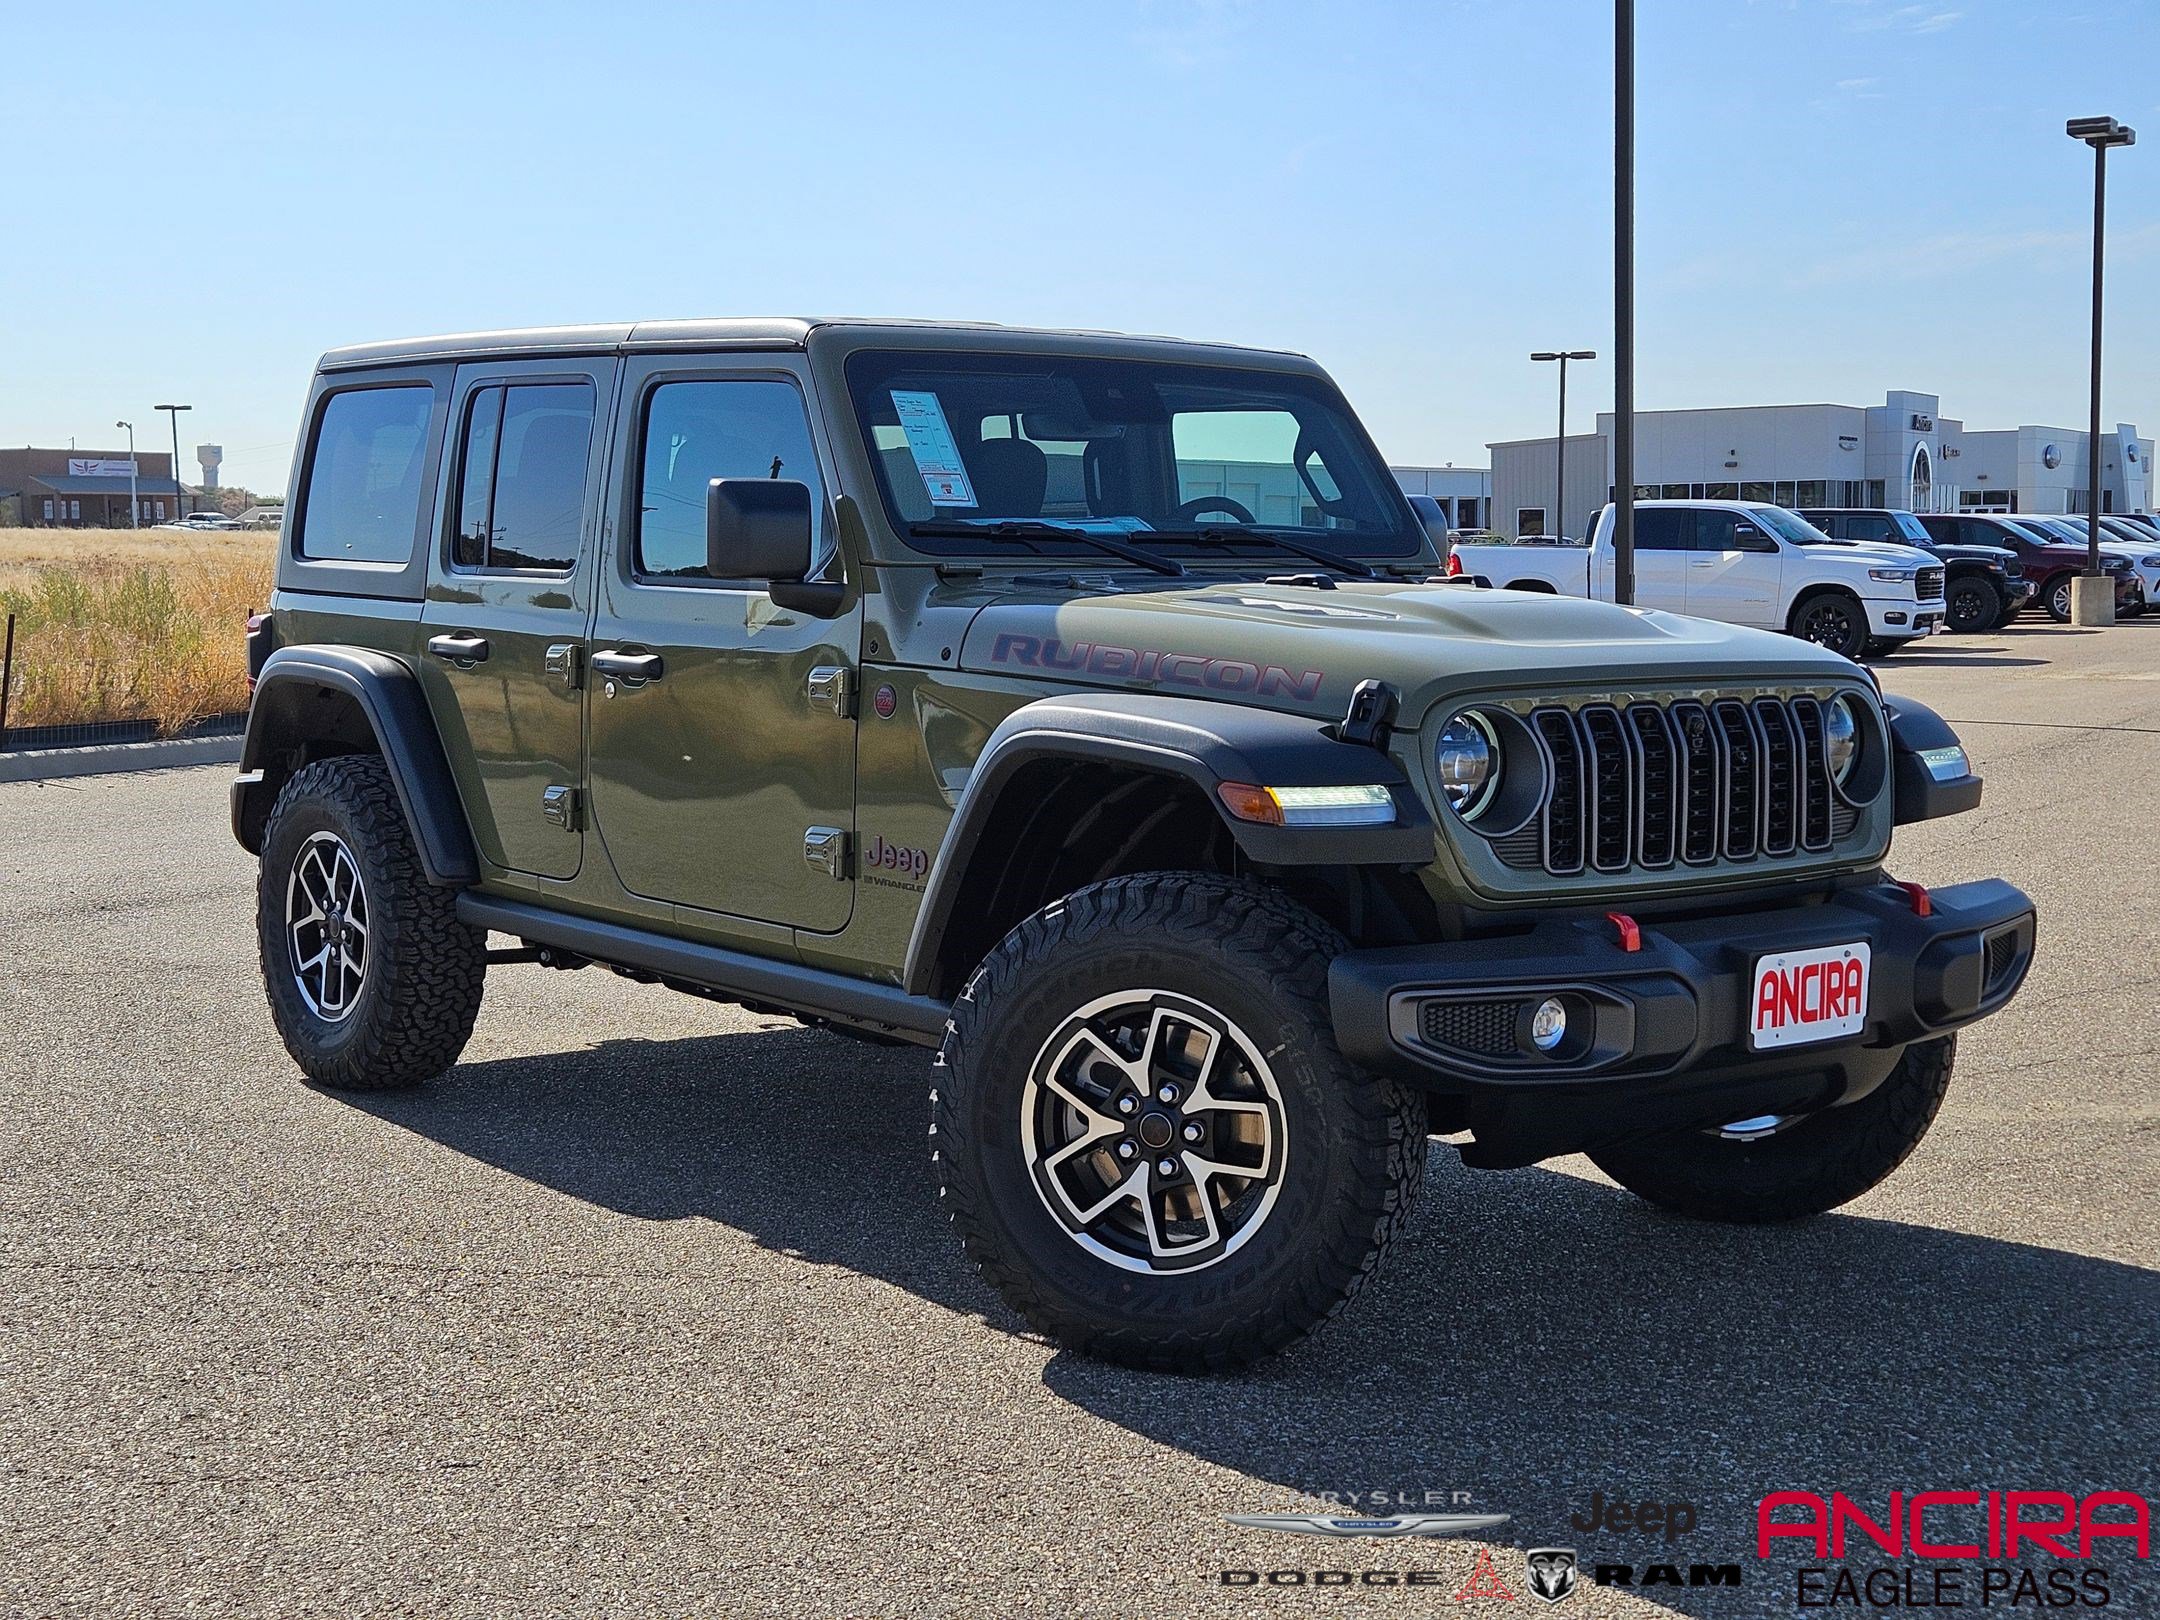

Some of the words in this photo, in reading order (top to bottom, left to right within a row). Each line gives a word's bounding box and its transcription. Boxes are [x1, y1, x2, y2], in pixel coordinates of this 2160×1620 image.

[992, 633, 1324, 701] RUBICON
[864, 834, 929, 881] Jeep
[1757, 957, 1863, 1031] ANCIRA
